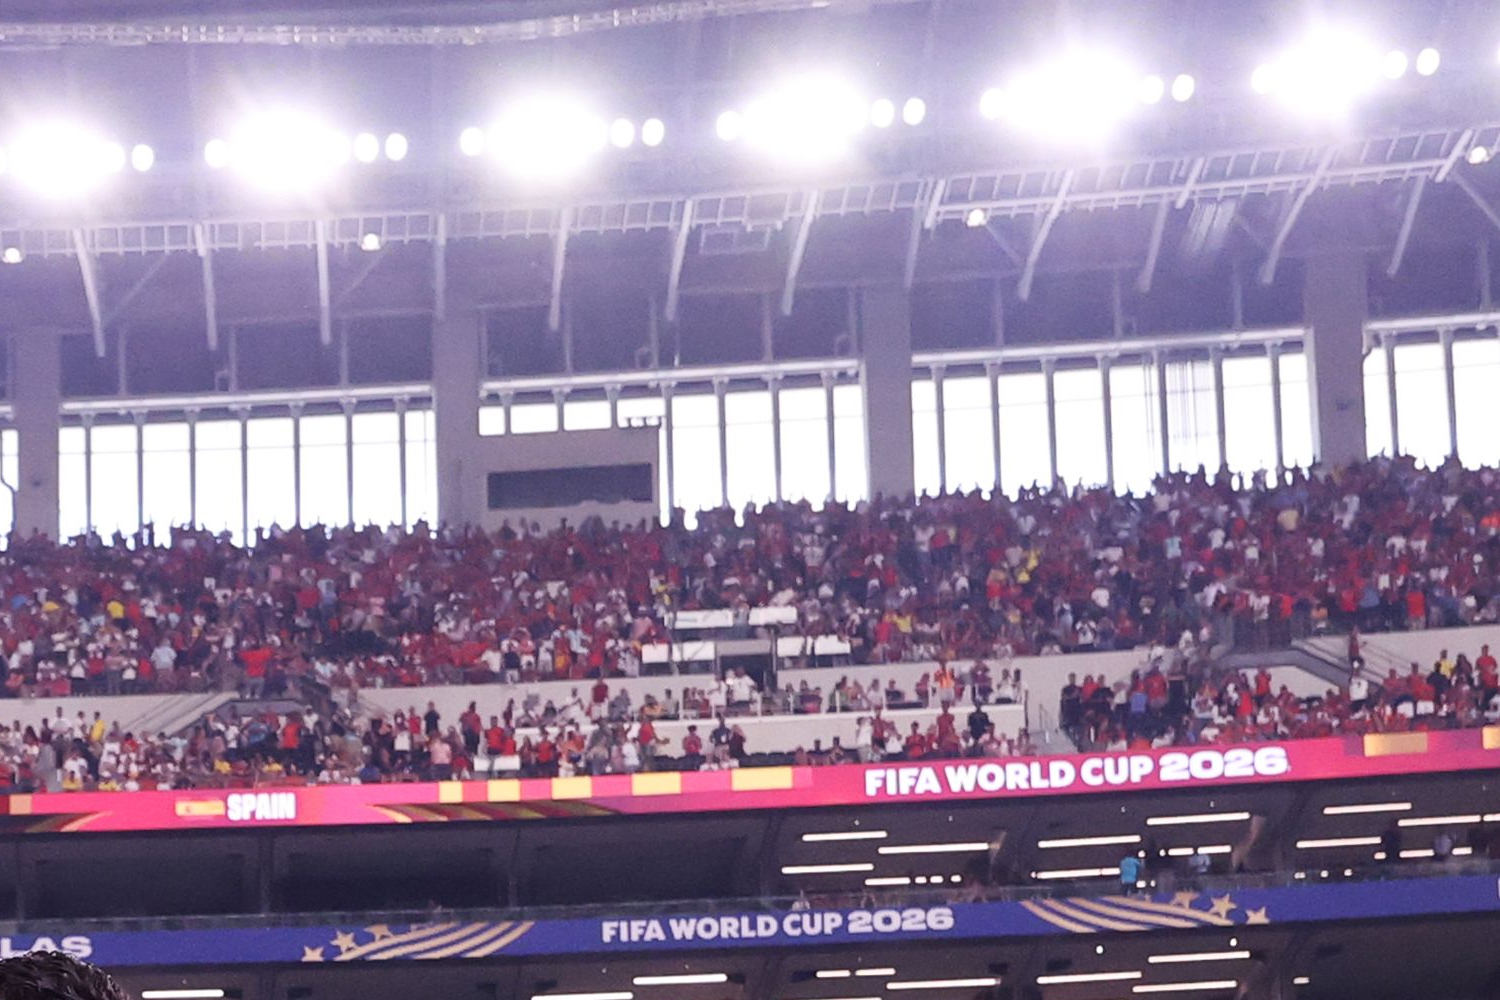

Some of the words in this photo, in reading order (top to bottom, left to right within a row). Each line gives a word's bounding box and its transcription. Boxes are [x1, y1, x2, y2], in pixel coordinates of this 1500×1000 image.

[864, 767, 942, 796] FIFA
[944, 761, 1076, 793] WORLD
[1080, 754, 1154, 785] CUP
[1159, 746, 1290, 782] 2026
[227, 792, 296, 821] SPAIN
[602, 919, 666, 943] FIFA
[669, 915, 778, 940] WORLD
[782, 911, 843, 937] CUP
[847, 907, 955, 934] 2026
